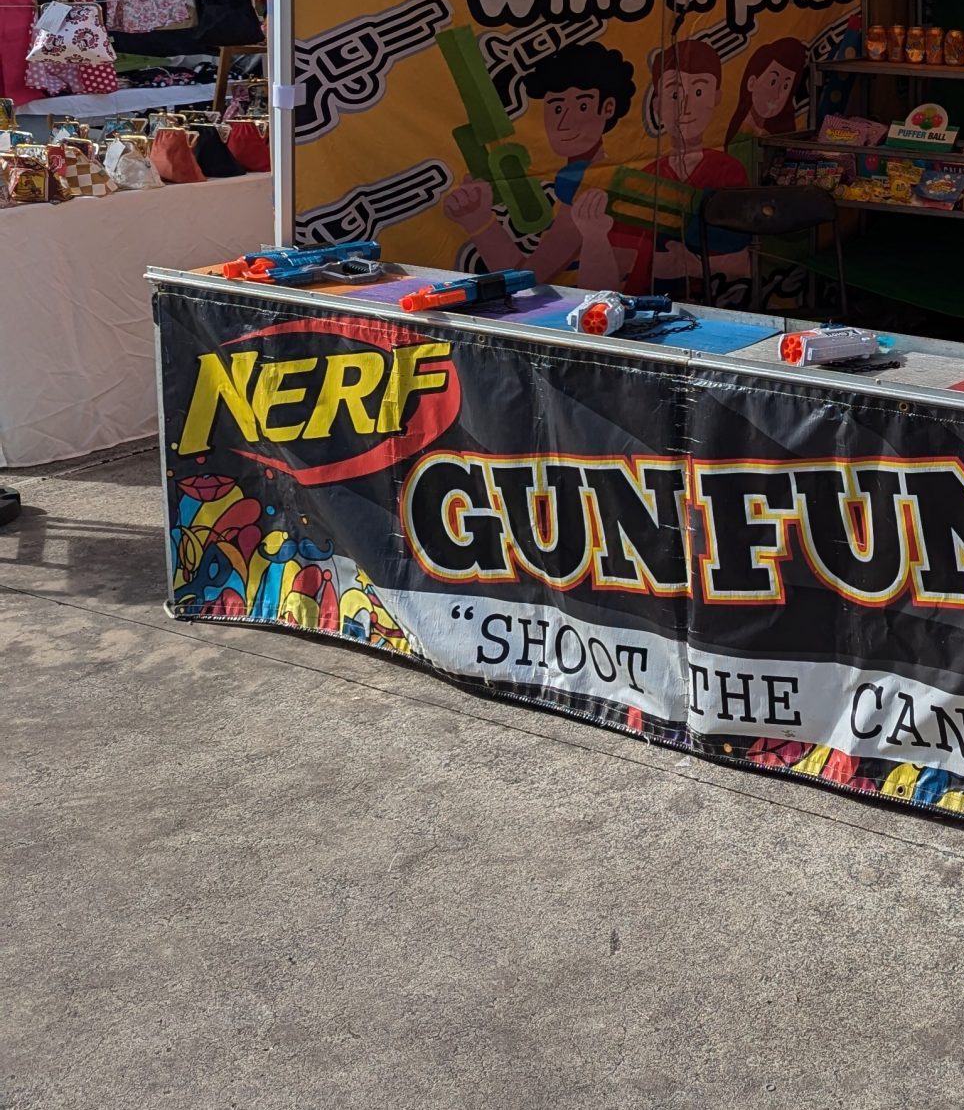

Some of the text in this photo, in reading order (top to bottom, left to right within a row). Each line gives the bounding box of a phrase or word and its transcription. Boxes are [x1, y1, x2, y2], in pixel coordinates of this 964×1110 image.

[898, 129, 946, 141] PUFFER BALL
[178, 341, 452, 457] NERF
[402, 450, 693, 598] GUN
[450, 605, 649, 695] “SHOOT
[689, 663, 802, 727] THE
